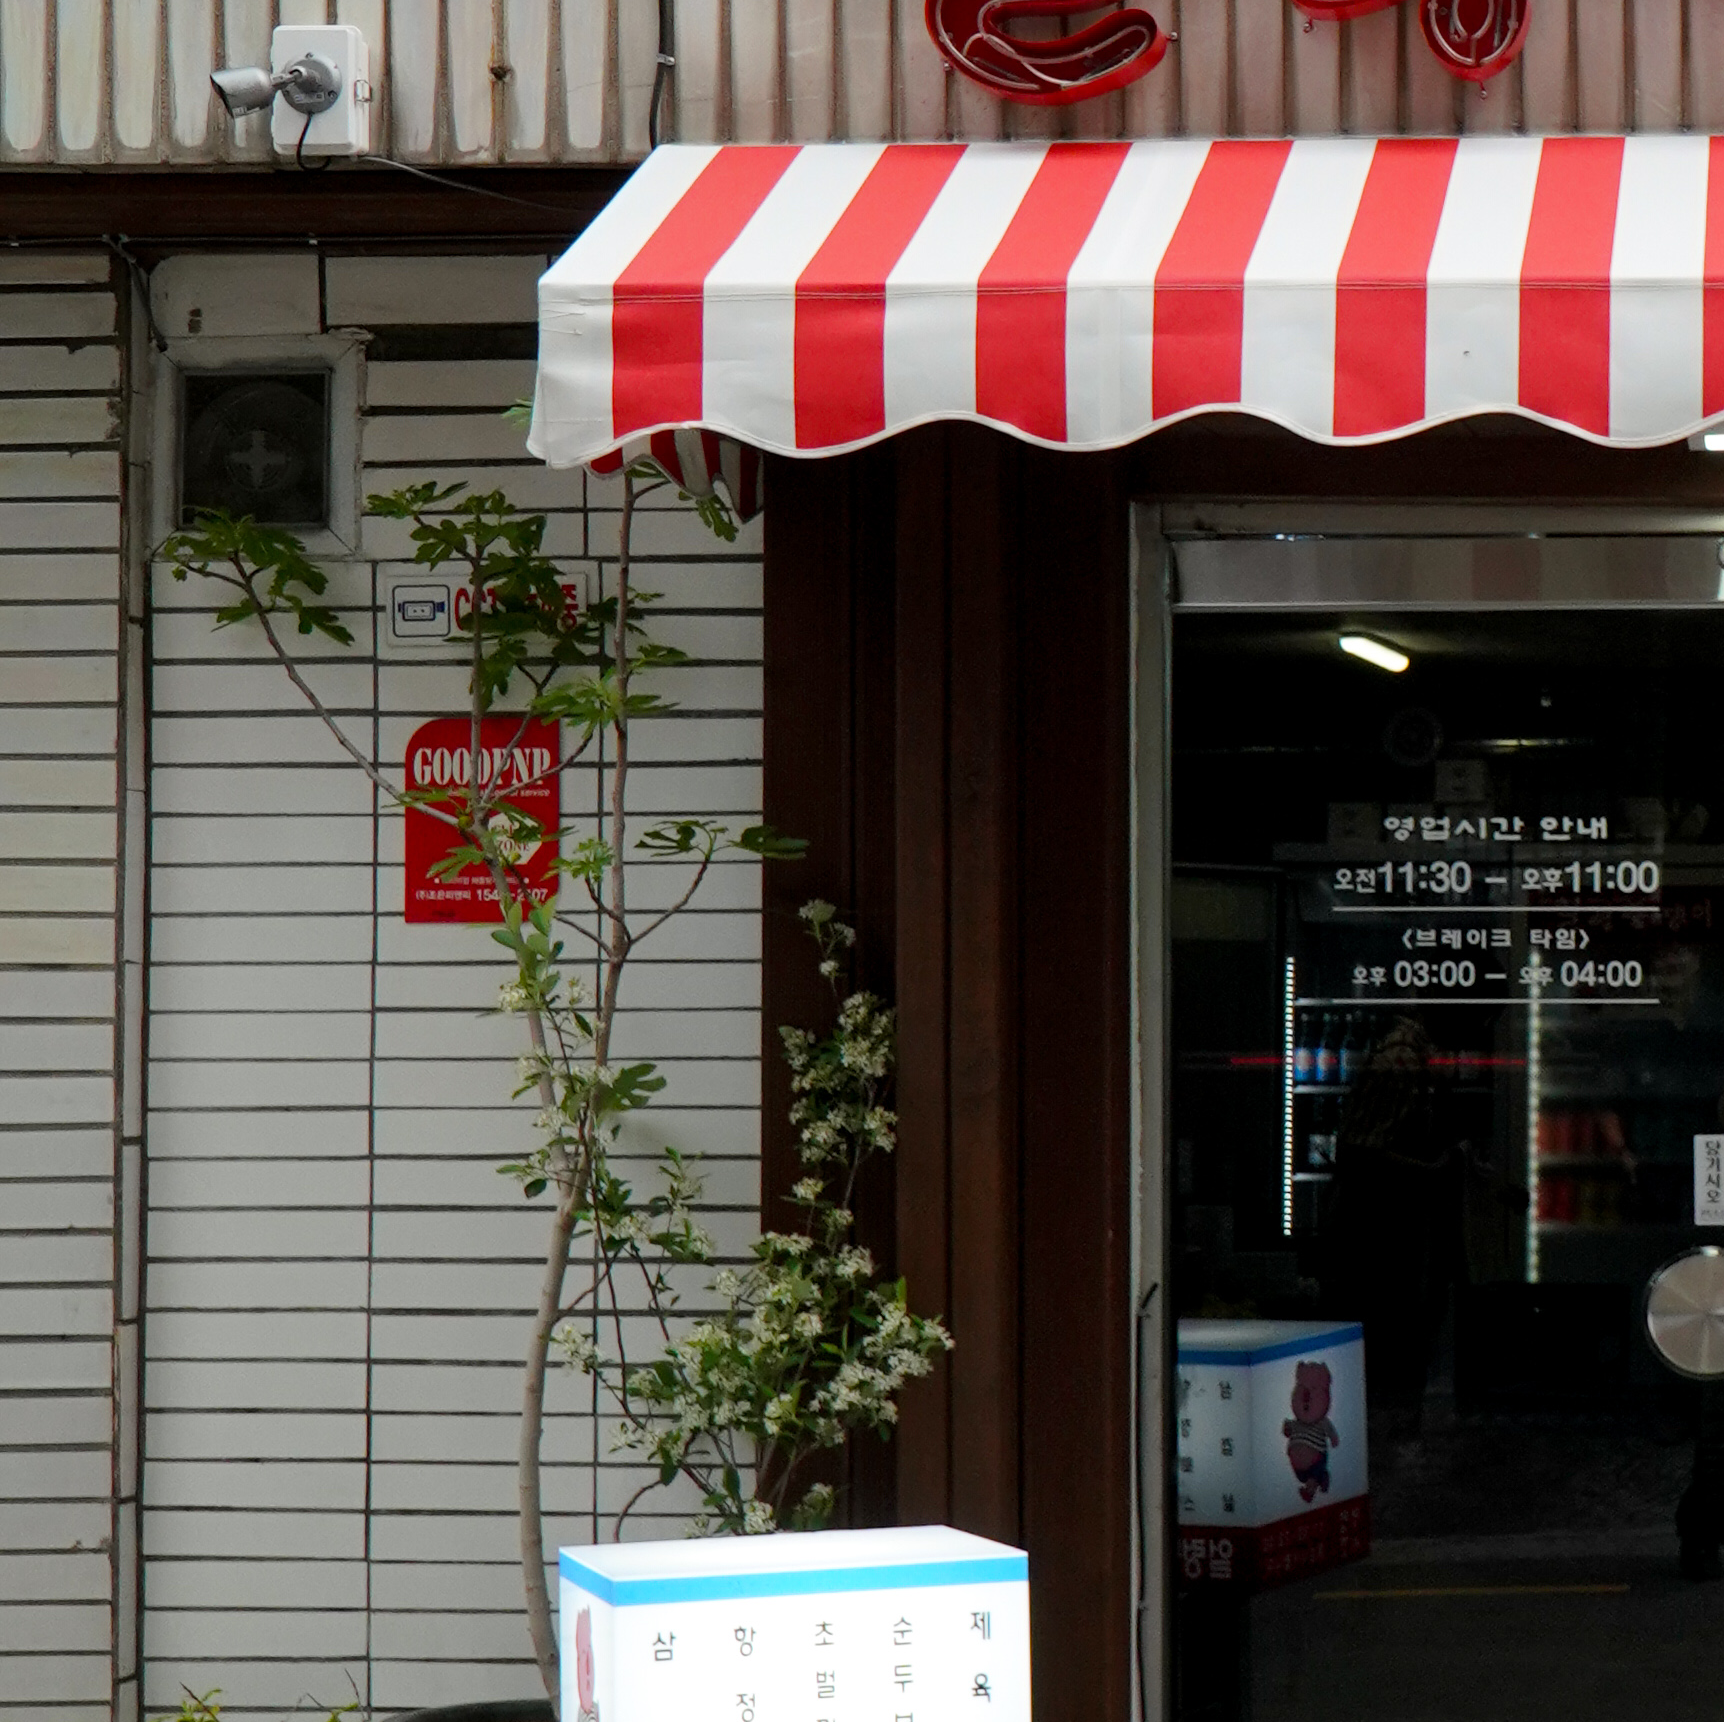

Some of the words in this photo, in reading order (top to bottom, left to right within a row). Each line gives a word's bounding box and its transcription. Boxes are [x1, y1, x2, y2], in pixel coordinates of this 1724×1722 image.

[1384, 815, 1523, 842] 영업시간
[1540, 815, 1608, 842] 안내
[1352, 964, 1387, 987] 오후
[1394, 960, 1476, 988] 03:00
[1560, 960, 1643, 988] 04:00
[1705, 1140, 1721, 1204] 당기시오
